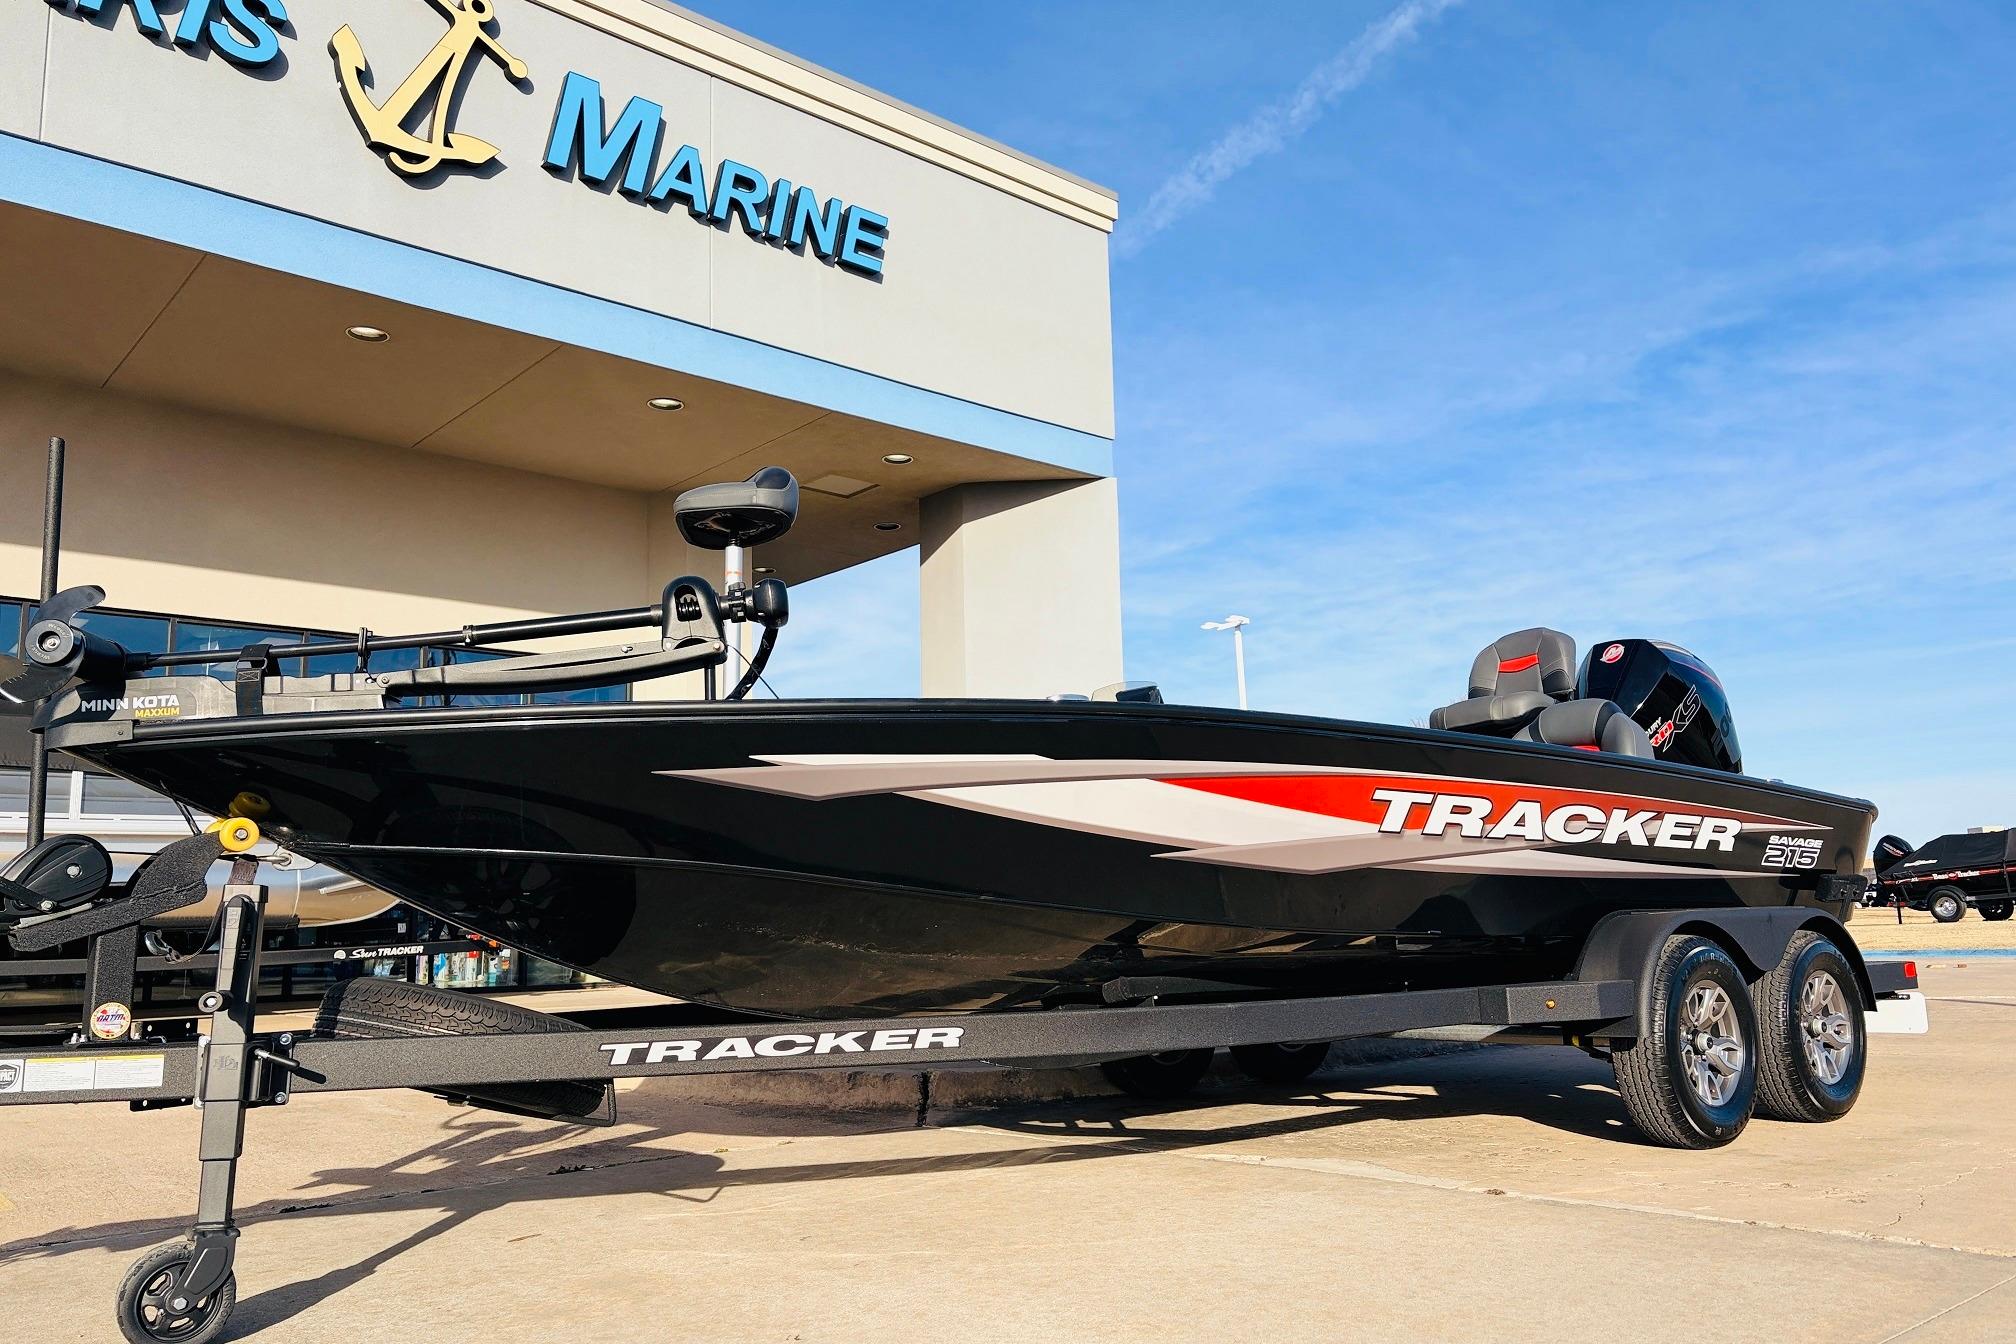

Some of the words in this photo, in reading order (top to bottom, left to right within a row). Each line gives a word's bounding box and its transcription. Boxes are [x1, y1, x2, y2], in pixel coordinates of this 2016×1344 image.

[81, 698, 129, 712] MINN
[132, 694, 180, 709] KOTA
[135, 707, 180, 718] MAXXUM
[1645, 716, 1661, 736] URY
[1373, 787, 1743, 852] TRACKER
[1768, 835, 1824, 848] SAVAGE
[1761, 844, 1820, 869] 215
[349, 948, 377, 959] Sun
[377, 945, 424, 957] TRACKER
[600, 1027, 965, 1066] TRACKER
